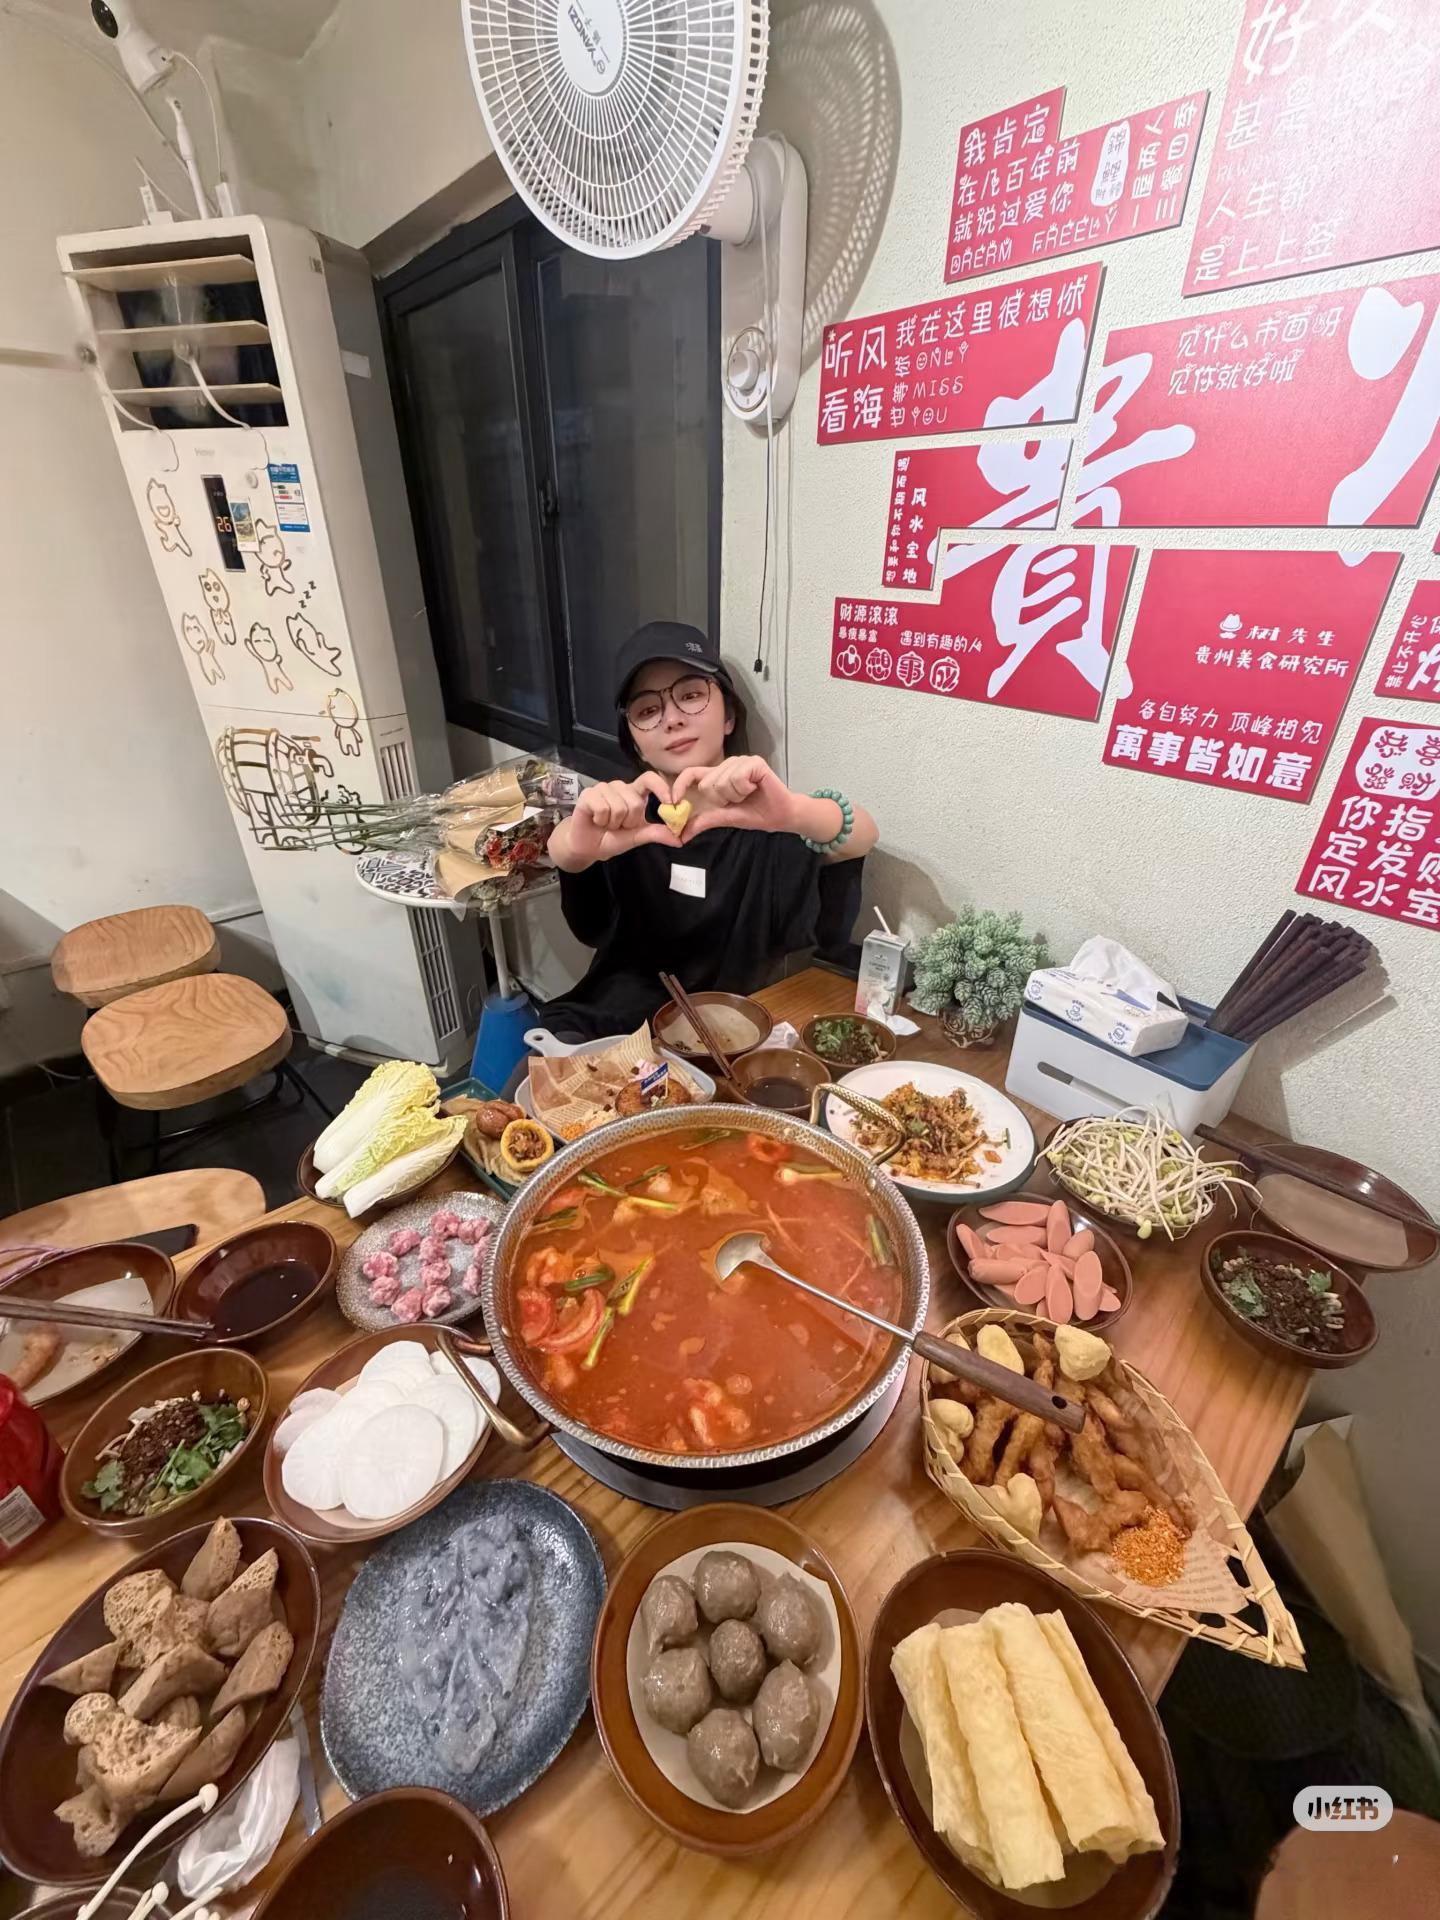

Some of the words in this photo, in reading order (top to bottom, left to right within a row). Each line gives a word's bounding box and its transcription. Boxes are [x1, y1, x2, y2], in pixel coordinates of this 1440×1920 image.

[963, 104, 1050, 168] 我肯定
[957, 138, 1080, 208] 在几百年前
[953, 181, 1074, 244] 就说过爱你
[1032, 206, 1118, 254] FREELY
[896, 274, 1088, 350] 我在这里很想你
[824, 326, 887, 378] 听风
[916, 341, 969, 370] ONLY
[1167, 349, 1305, 396] 见你就好啦
[821, 384, 884, 434] 看海
[912, 375, 963, 400] MISS
[911, 405, 948, 427] YOU
[216, 516, 232, 533] 26
[902, 488, 927, 583] 风水宝地
[839, 603, 899, 626] 财源滚滚
[900, 630, 983, 653] 遇到有趣的人
[1195, 645, 1350, 679] 贵州美食研究所
[1138, 698, 1219, 730] 各自努力
[1228, 711, 1324, 745] 顶峰相见
[1111, 723, 1313, 792] 萬事皆如意
[1338, 796, 1440, 844] 你指
